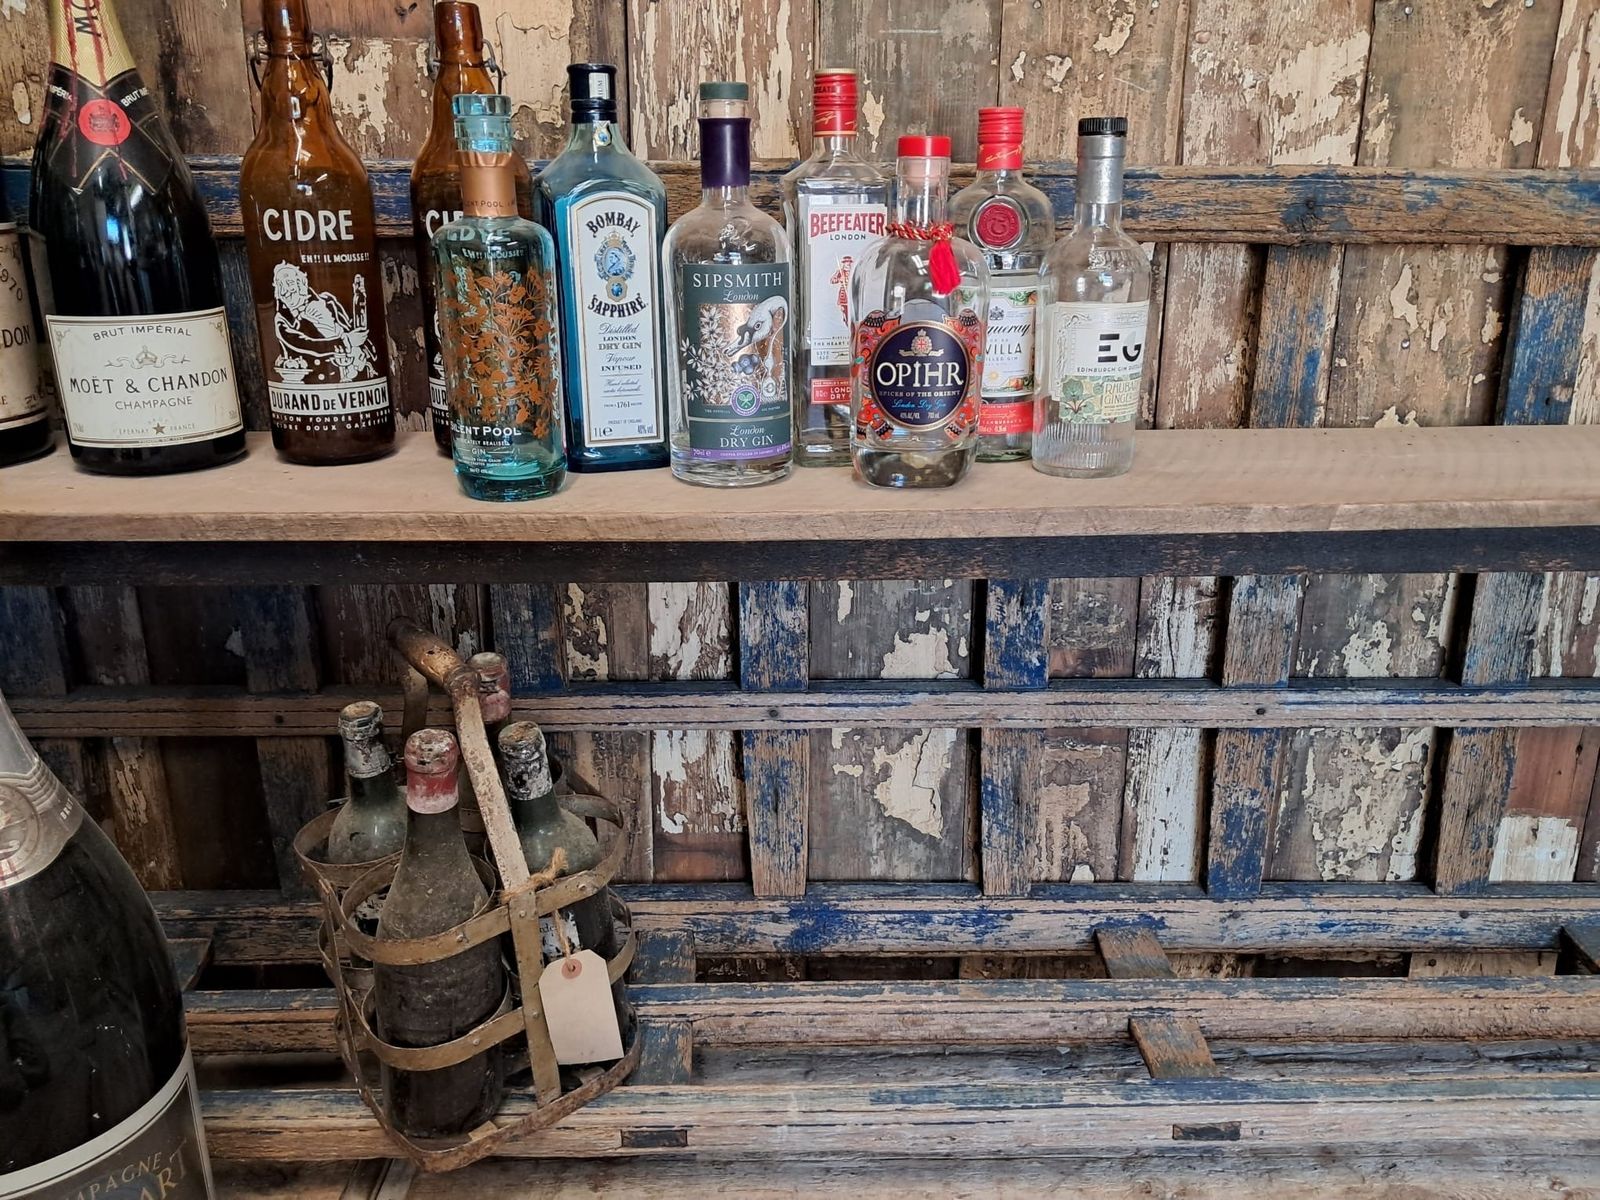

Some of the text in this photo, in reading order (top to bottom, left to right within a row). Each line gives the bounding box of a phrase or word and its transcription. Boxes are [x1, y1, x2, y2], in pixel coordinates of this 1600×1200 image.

[121, 90, 140, 107] BRUT
[263, 208, 354, 241] CIDRE
[586, 212, 641, 238] BOMBAY
[811, 213, 885, 237] BEEFEATER
[301, 252, 369, 264] EH!! IL MOUSSE!!
[693, 272, 782, 288] SIPSMITH
[723, 289, 759, 303] London
[587, 293, 647, 318] SAPPHIRE
[92, 324, 192, 341] BRUT IMPÉRIAL
[598, 322, 640, 335] Distilled
[622, 342, 642, 350] GIN
[986, 343, 1022, 354] VILLA
[69, 367, 228, 394] MOËT & CHANDON
[877, 361, 964, 387] OPIHR
[115, 396, 193, 410] CHAMPAGNE
[271, 386, 388, 411] DURAND DE VERNON
[616, 401, 631, 409] 1761
[892, 399, 916, 408] London
[272, 413, 302, 422] MAISON
[276, 422, 299, 431] CIDRE
[450, 421, 480, 435] SILENT
[482, 426, 522, 437] POOL
[730, 424, 764, 436] London
[720, 434, 774, 448] DRY GIN
[60, 798, 74, 820] BRUT
